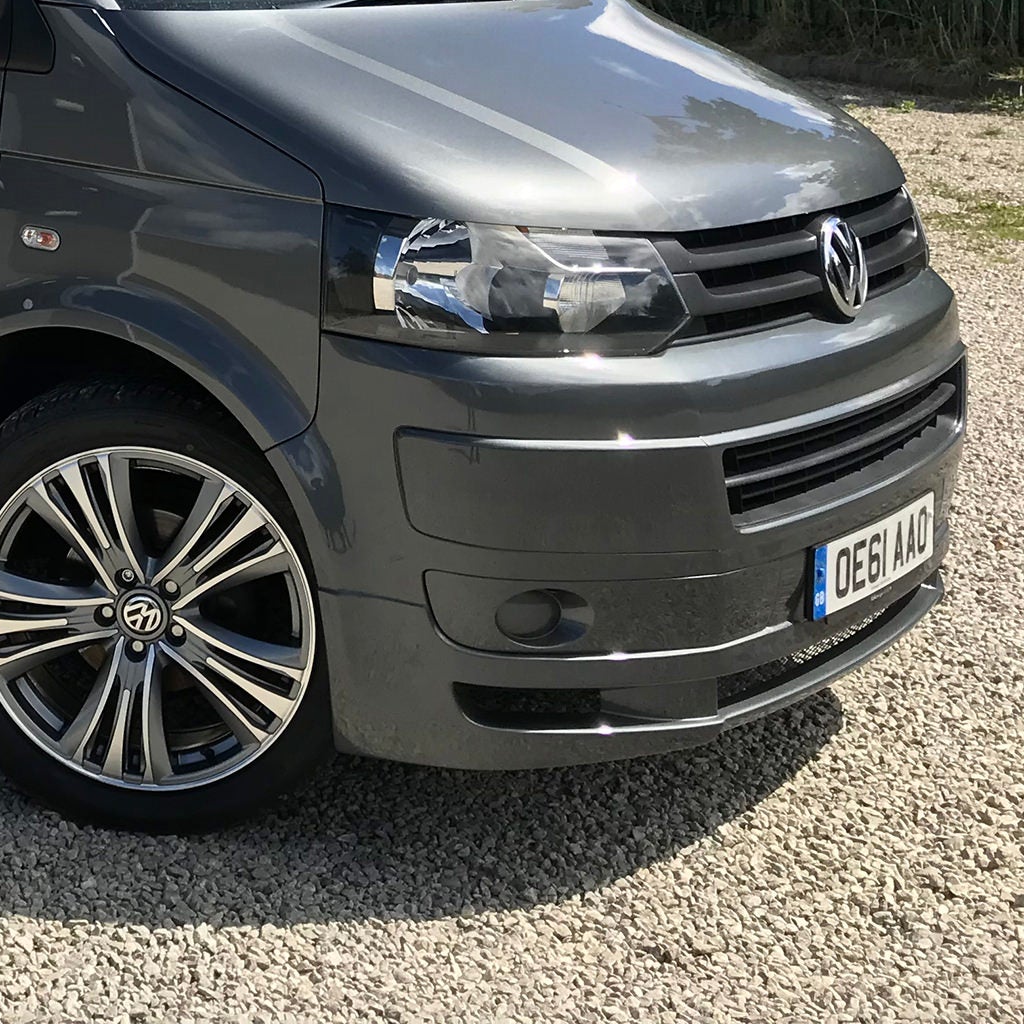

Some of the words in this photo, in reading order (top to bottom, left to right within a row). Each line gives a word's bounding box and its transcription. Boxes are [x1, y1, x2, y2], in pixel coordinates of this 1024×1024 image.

[835, 528, 888, 599] OE61
[892, 506, 928, 571] AAO
[814, 591, 825, 607] GB
